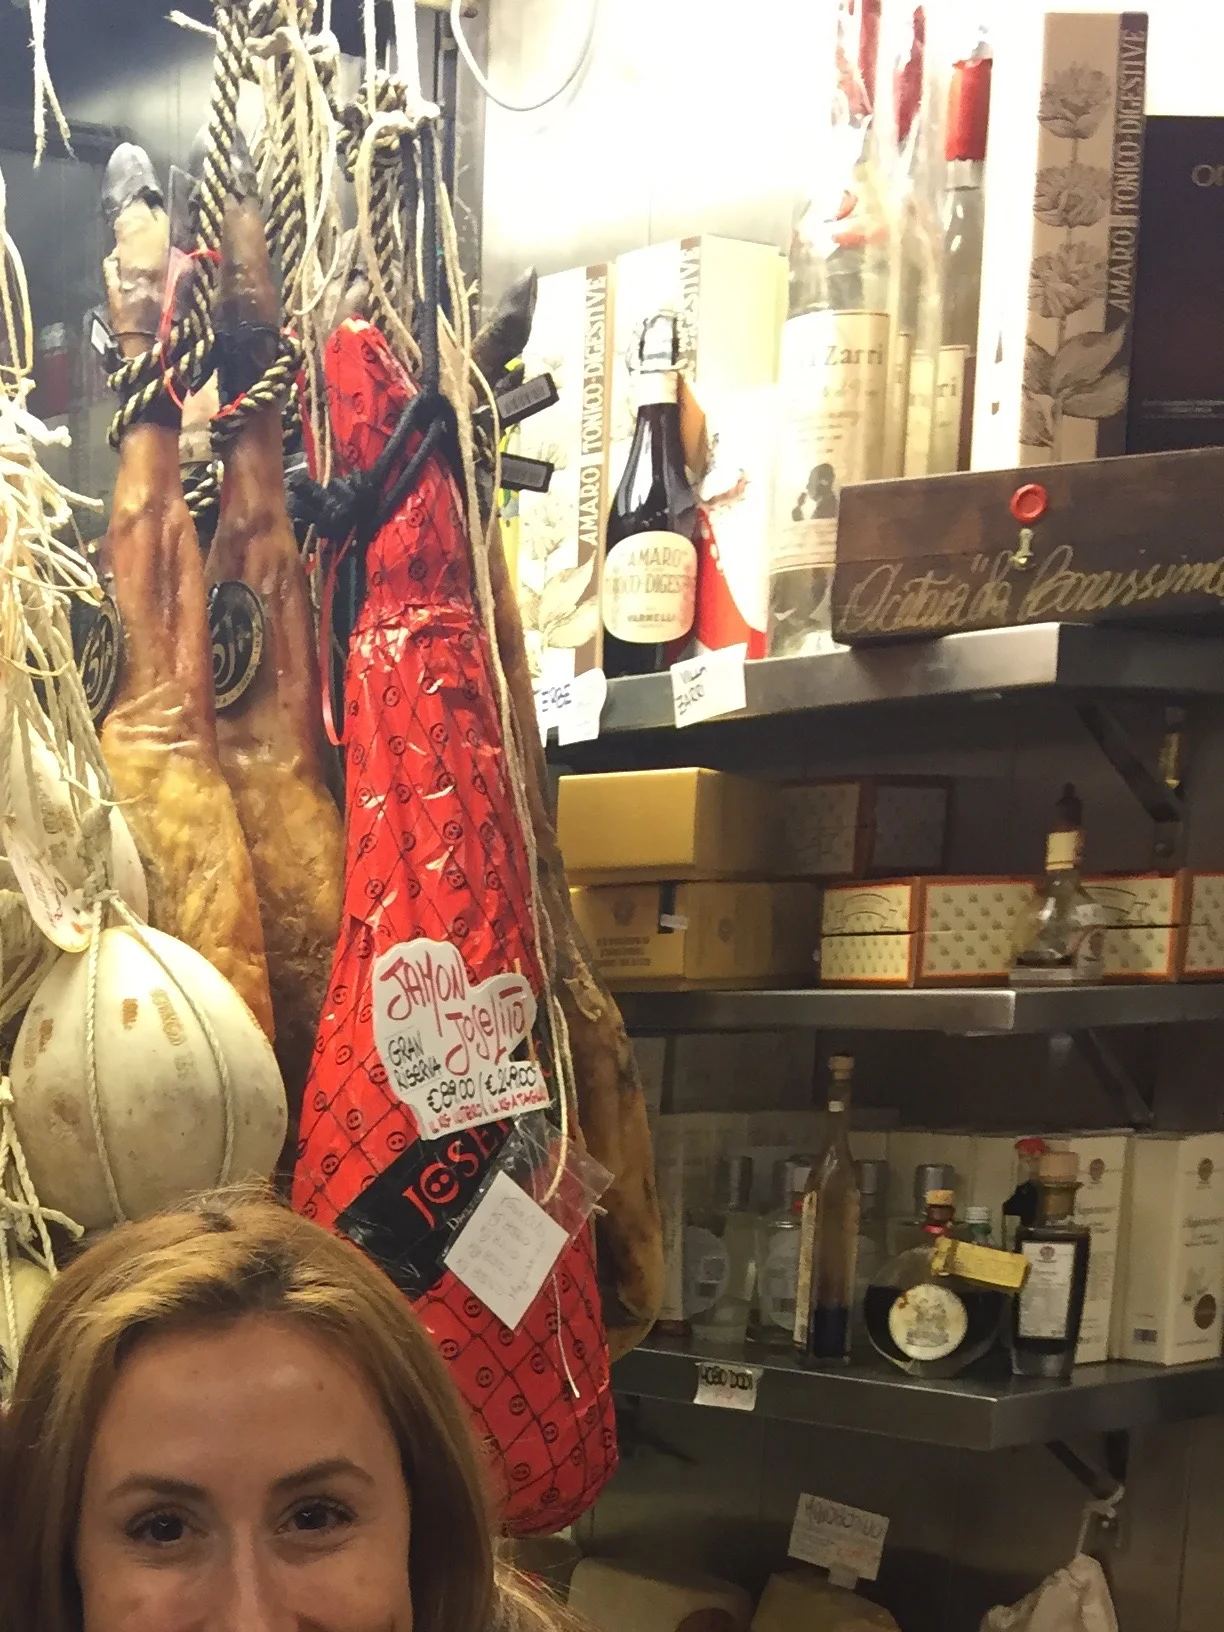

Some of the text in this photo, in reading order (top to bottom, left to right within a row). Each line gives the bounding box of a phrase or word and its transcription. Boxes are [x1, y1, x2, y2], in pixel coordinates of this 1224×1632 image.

[1108, 229, 1137, 313] AMARO
[578, 466, 601, 546] AMARO
[379, 950, 466, 1038] JAMON
